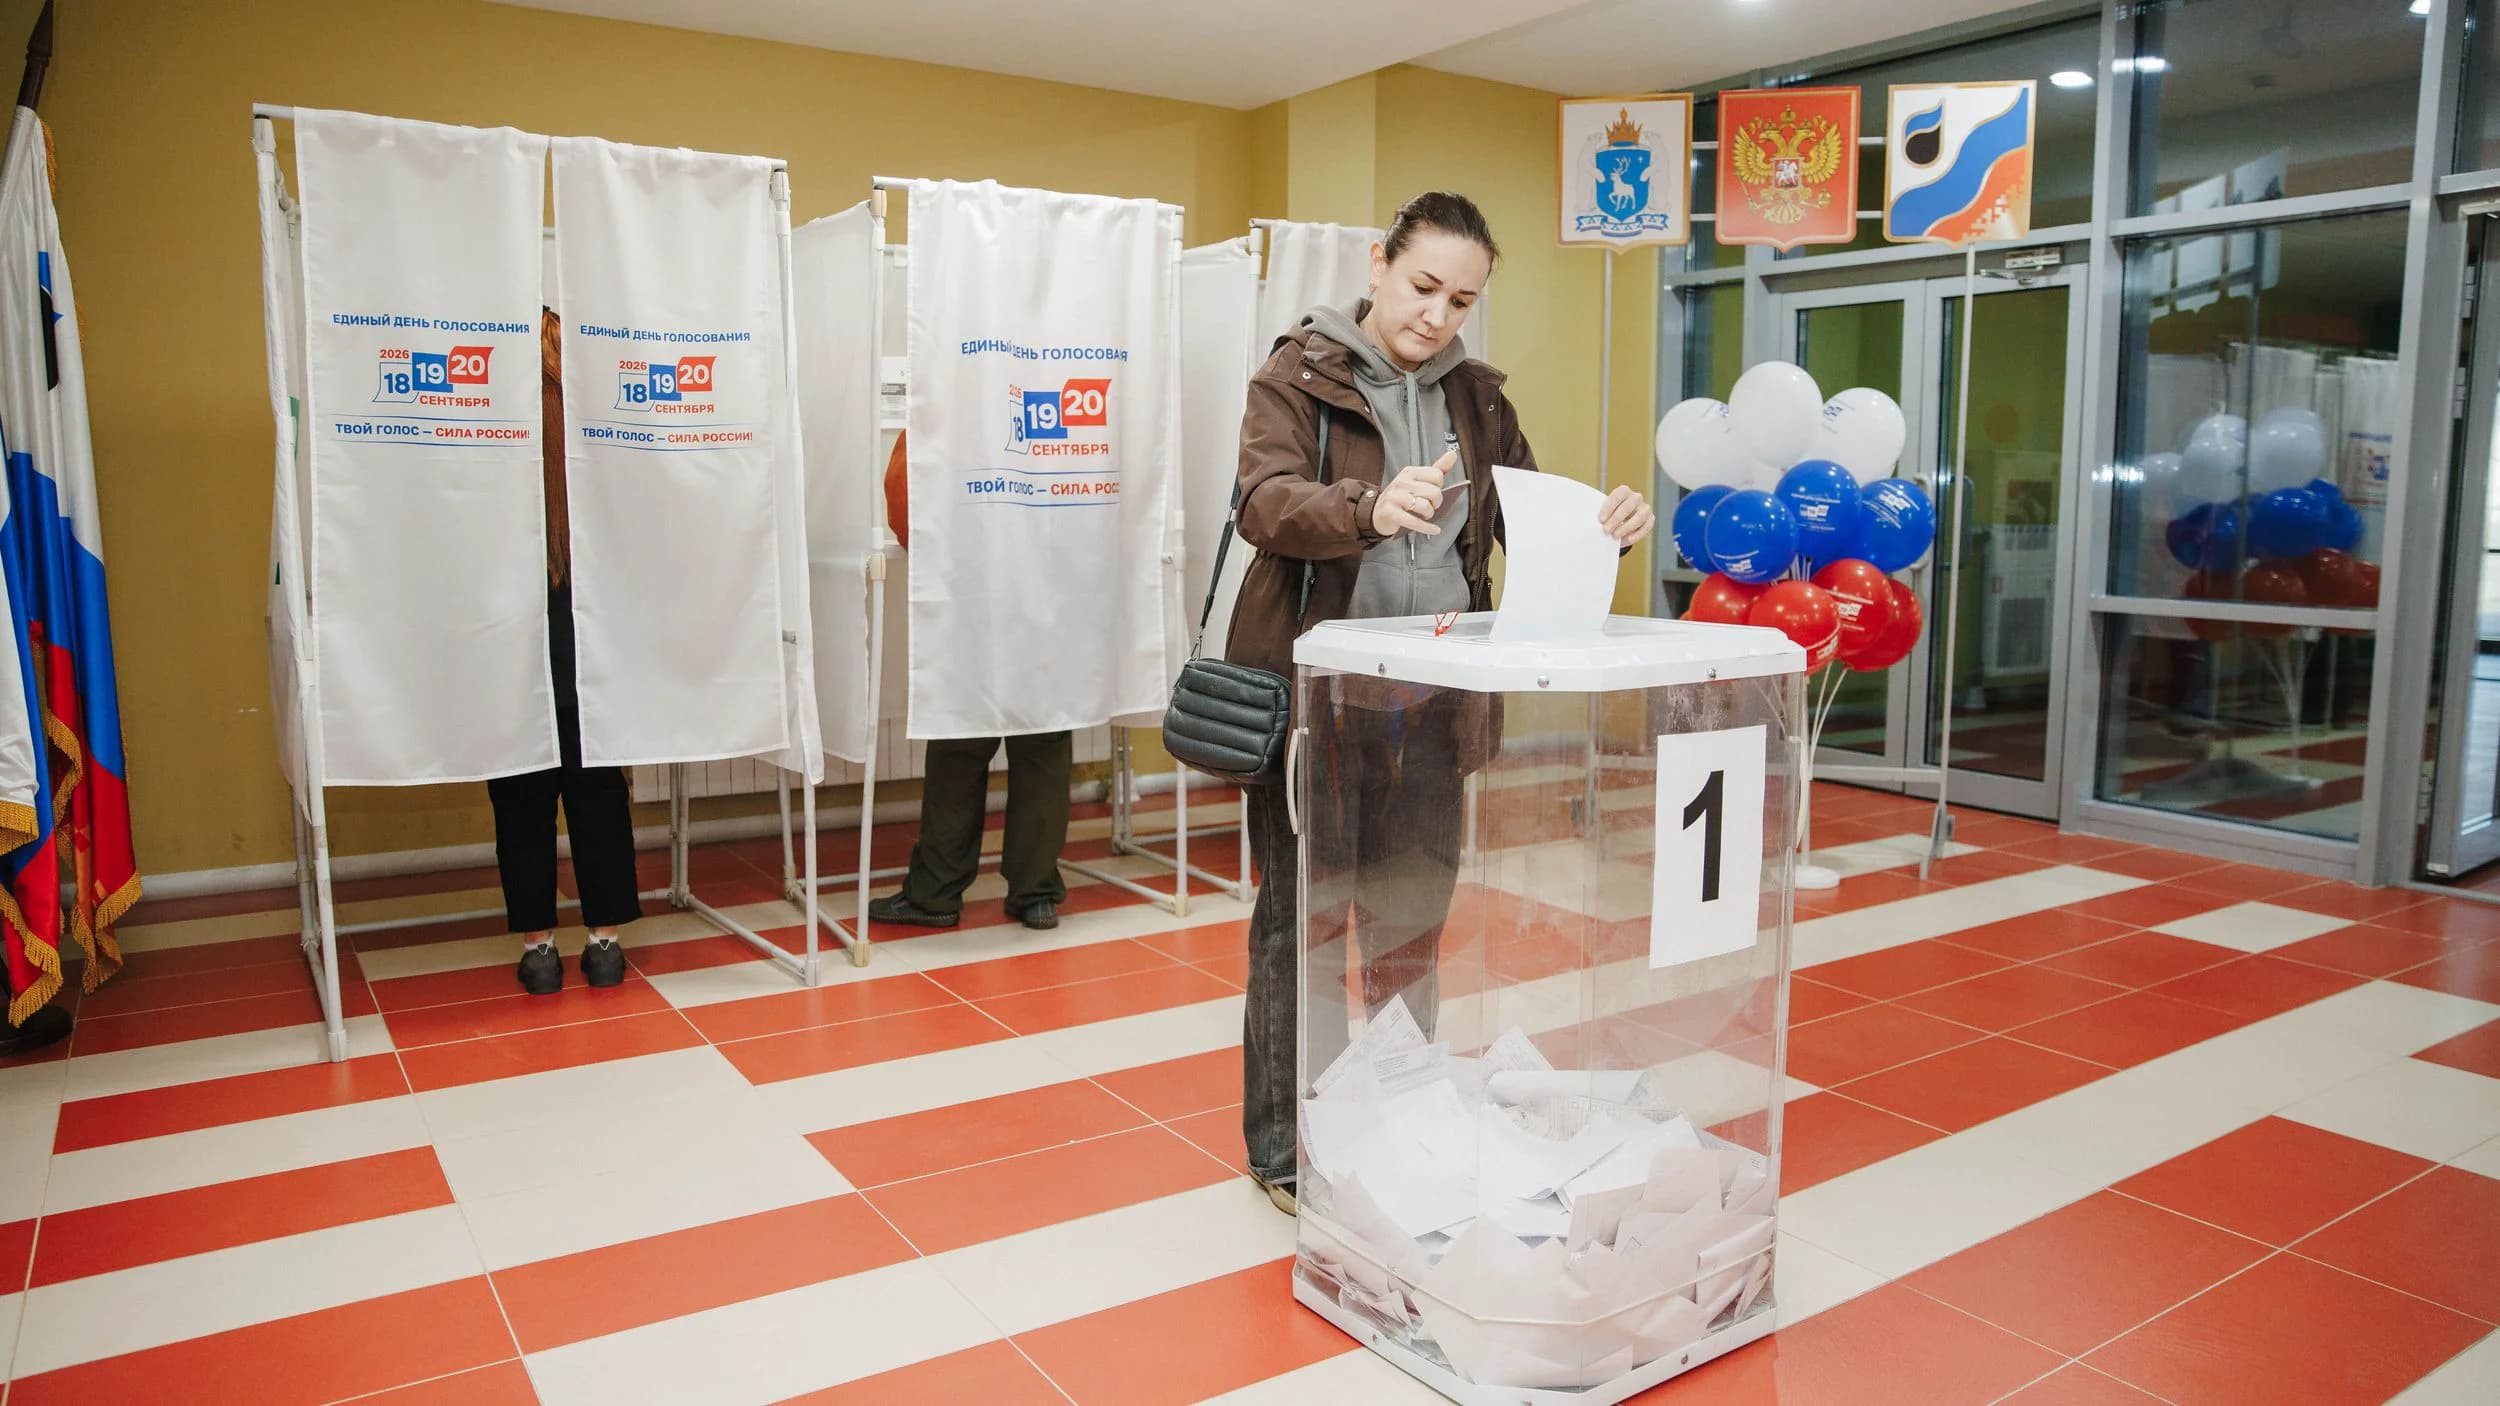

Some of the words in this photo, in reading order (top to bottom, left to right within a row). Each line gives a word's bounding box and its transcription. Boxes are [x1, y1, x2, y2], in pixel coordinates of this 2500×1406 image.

[333, 314, 390, 326] ЕДИНЫЙ
[394, 316, 430, 328] ДЕНЬ
[434, 319, 530, 334] ГОЛОСОВАНИЯ
[580, 325, 630, 338] ЕДИНЫЙ
[633, 331, 661, 341] ДЕНЬ
[664, 332, 750, 342] ГОЛОСОВАНИЯ
[379, 349, 410, 359] 2026
[619, 360, 647, 370] 2026
[384, 373, 411, 394] 18
[416, 362, 445, 384] 19
[451, 355, 485, 376] 20
[623, 383, 647, 403] 18
[652, 373, 675, 393] 19
[679, 364, 709, 384] 20
[419, 395, 490, 407] СЕНТЯБРЯ
[655, 404, 714, 413] СЕНТЯБРЯ
[1026, 403, 1057, 429] 19
[1064, 389, 1104, 416] 20
[335, 423, 372, 435] ТВОЙ
[377, 425, 419, 436] ГОЛОС
[435, 427, 473, 438] СИЛА
[477, 429, 530, 439] РОССИИ!
[582, 427, 613, 438] ТВОЙ
[616, 431, 655, 442] ГОЛОС
[668, 433, 699, 442] СИЛА
[703, 432, 753, 442] РОССИИ!
[1032, 443, 1109, 455] СЕНТЯБРЯ
[966, 477, 1005, 493] ТВОЙ
[1051, 483, 1090, 495] СИЛА
[1683, 770, 1724, 902] 1
